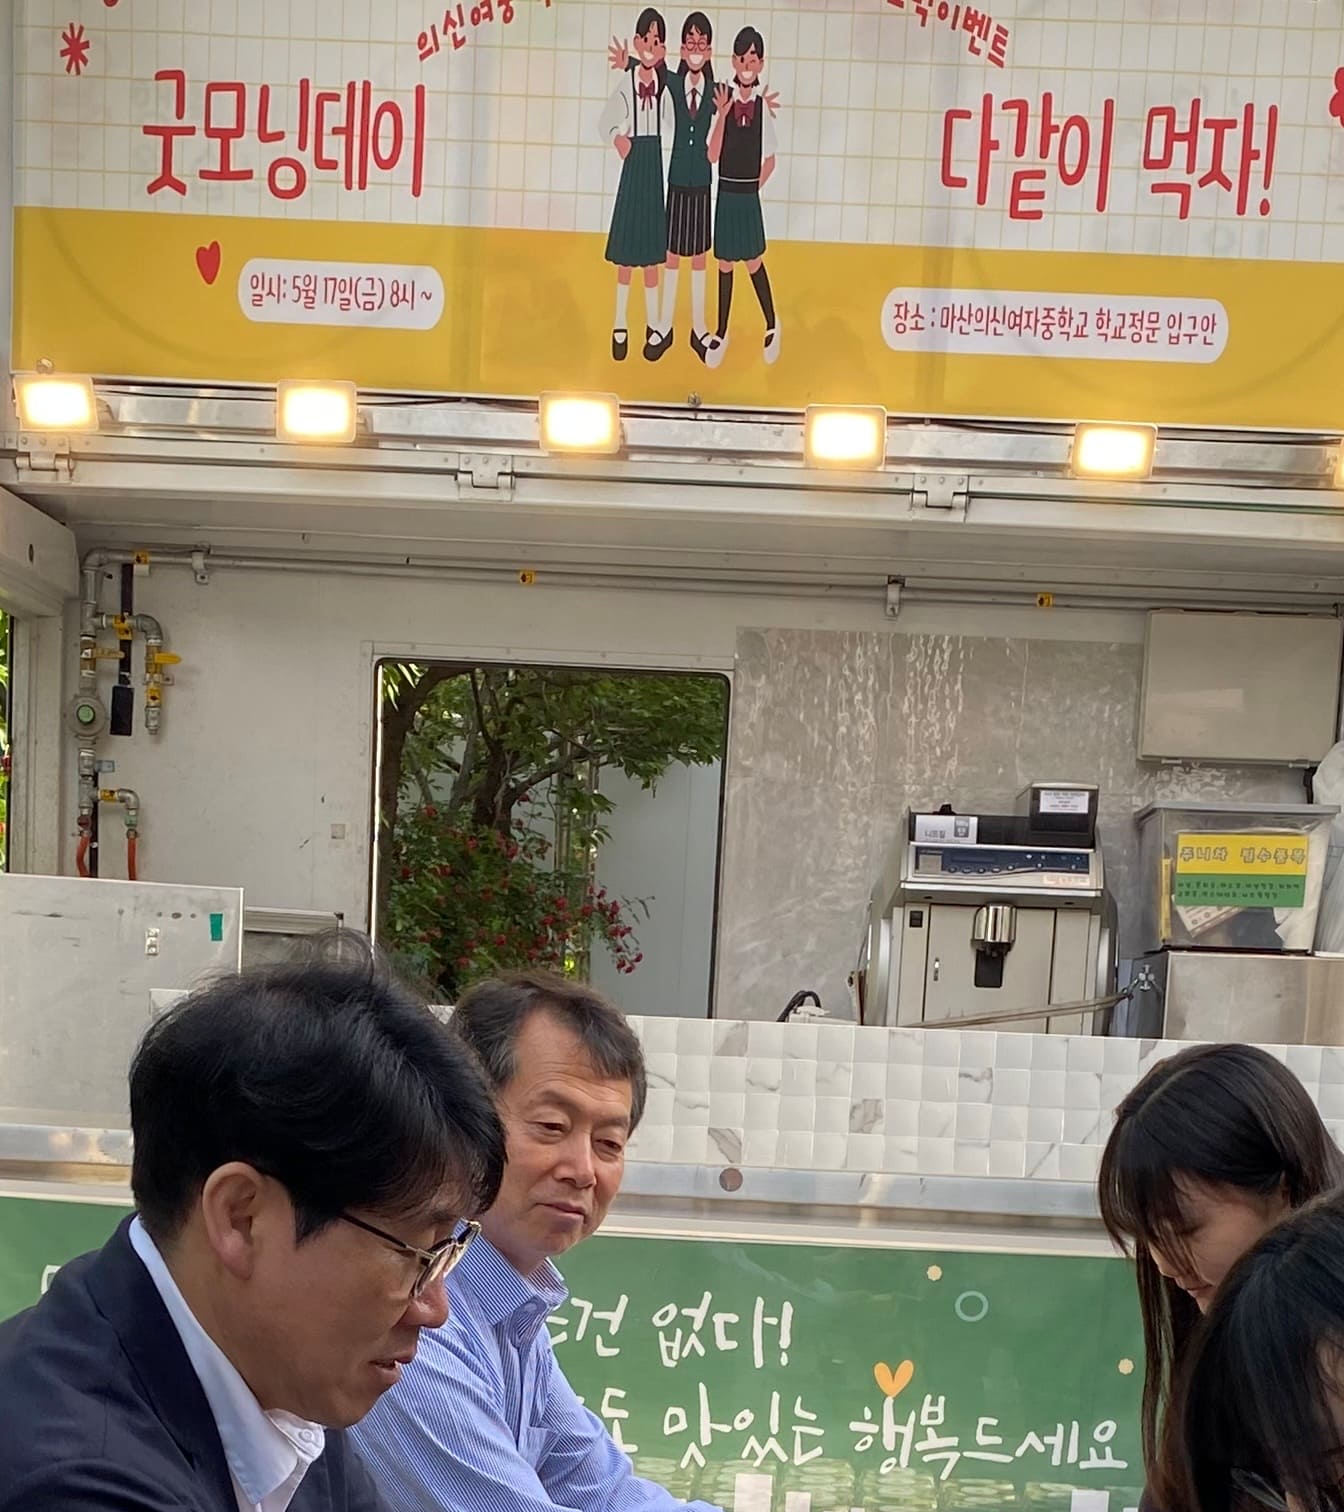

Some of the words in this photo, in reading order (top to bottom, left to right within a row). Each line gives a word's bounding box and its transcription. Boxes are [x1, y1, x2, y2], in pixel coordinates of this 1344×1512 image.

[143, 69, 426, 200] 굿모닝데이
[940, 92, 1114, 220] 다같이
[1142, 98, 1279, 220] 먹자!
[249, 272, 288, 308] 일시:
[291, 274, 319, 310] 5월
[323, 276, 386, 312] 17일(금)
[390, 279, 416, 311] 8시
[940, 303, 1089, 342] 마산의신여자중학교
[1095, 307, 1161, 345] 학교정문
[1166, 312, 1218, 347] 입구안
[651, 1290, 794, 1369] 없다!
[663, 1380, 826, 1469] 맛있는
